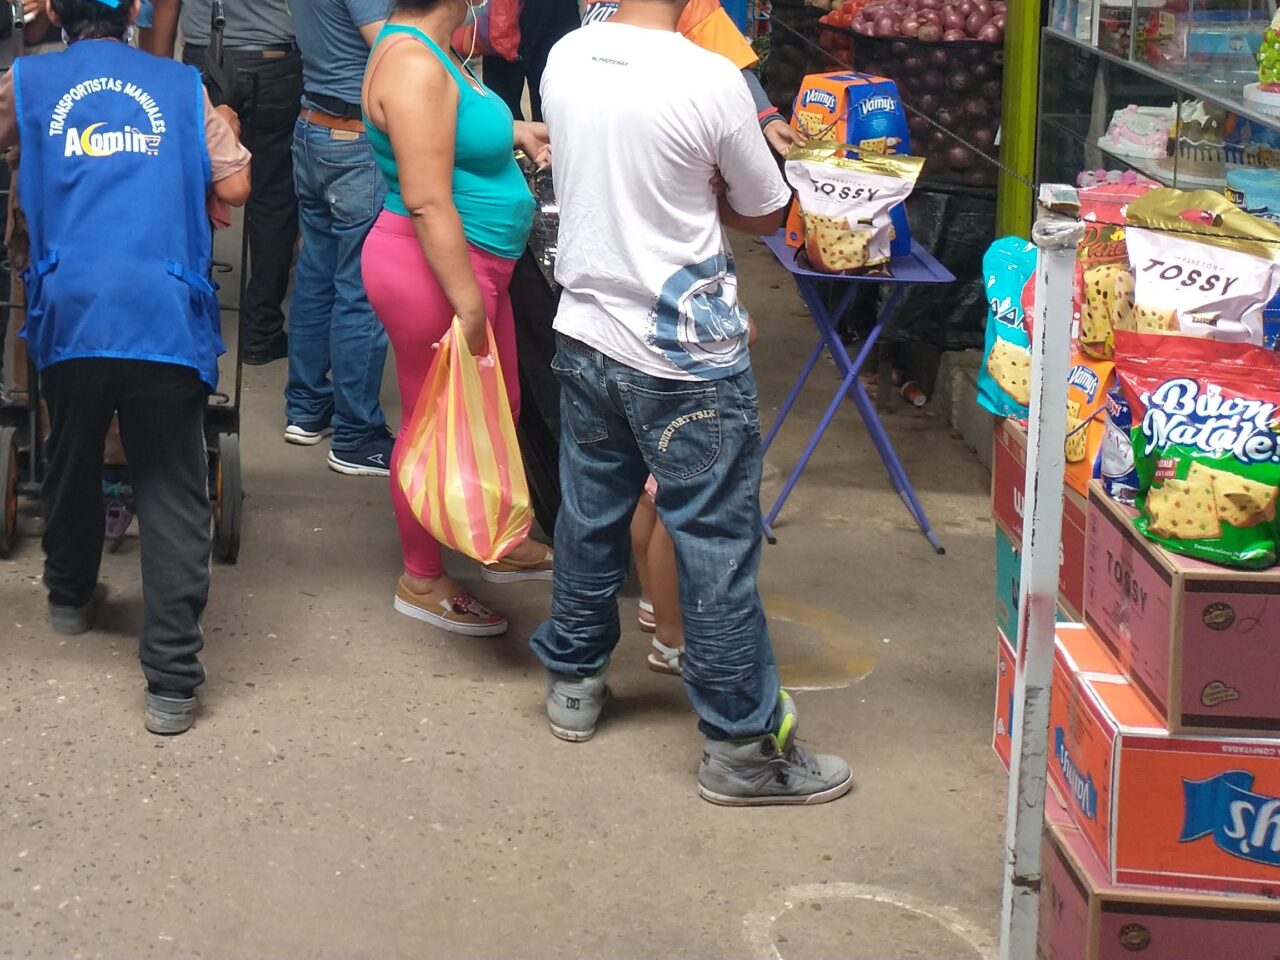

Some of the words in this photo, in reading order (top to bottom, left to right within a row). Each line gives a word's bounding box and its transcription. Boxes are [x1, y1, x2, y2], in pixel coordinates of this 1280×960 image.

[49, 77, 123, 137] TRANSPORTISTAS
[123, 82, 167, 135] MANUALES
[805, 89, 837, 109] Vamy's
[861, 96, 895, 114] Vamy's
[810, 178, 880, 201] TOSSY
[1142, 258, 1239, 296] TOSSY
[1144, 378, 1276, 431] Buon
[1106, 549, 1148, 614] TOSSY
